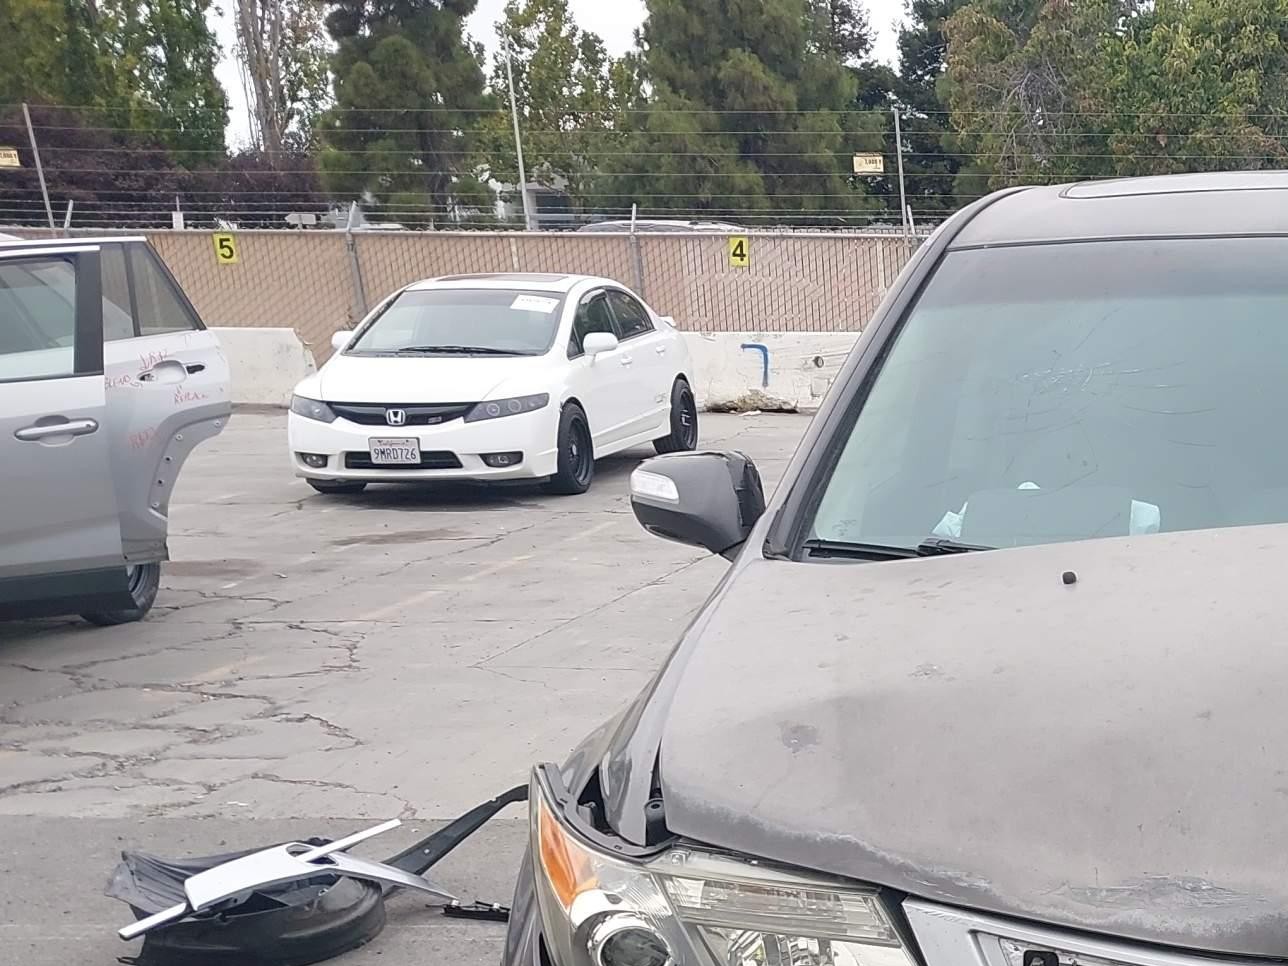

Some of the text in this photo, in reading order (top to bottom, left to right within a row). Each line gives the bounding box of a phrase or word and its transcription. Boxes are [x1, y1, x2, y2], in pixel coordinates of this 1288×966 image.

[218, 237, 234, 260] 5
[732, 239, 747, 262] 4
[373, 447, 417, 460] 9MRD726
